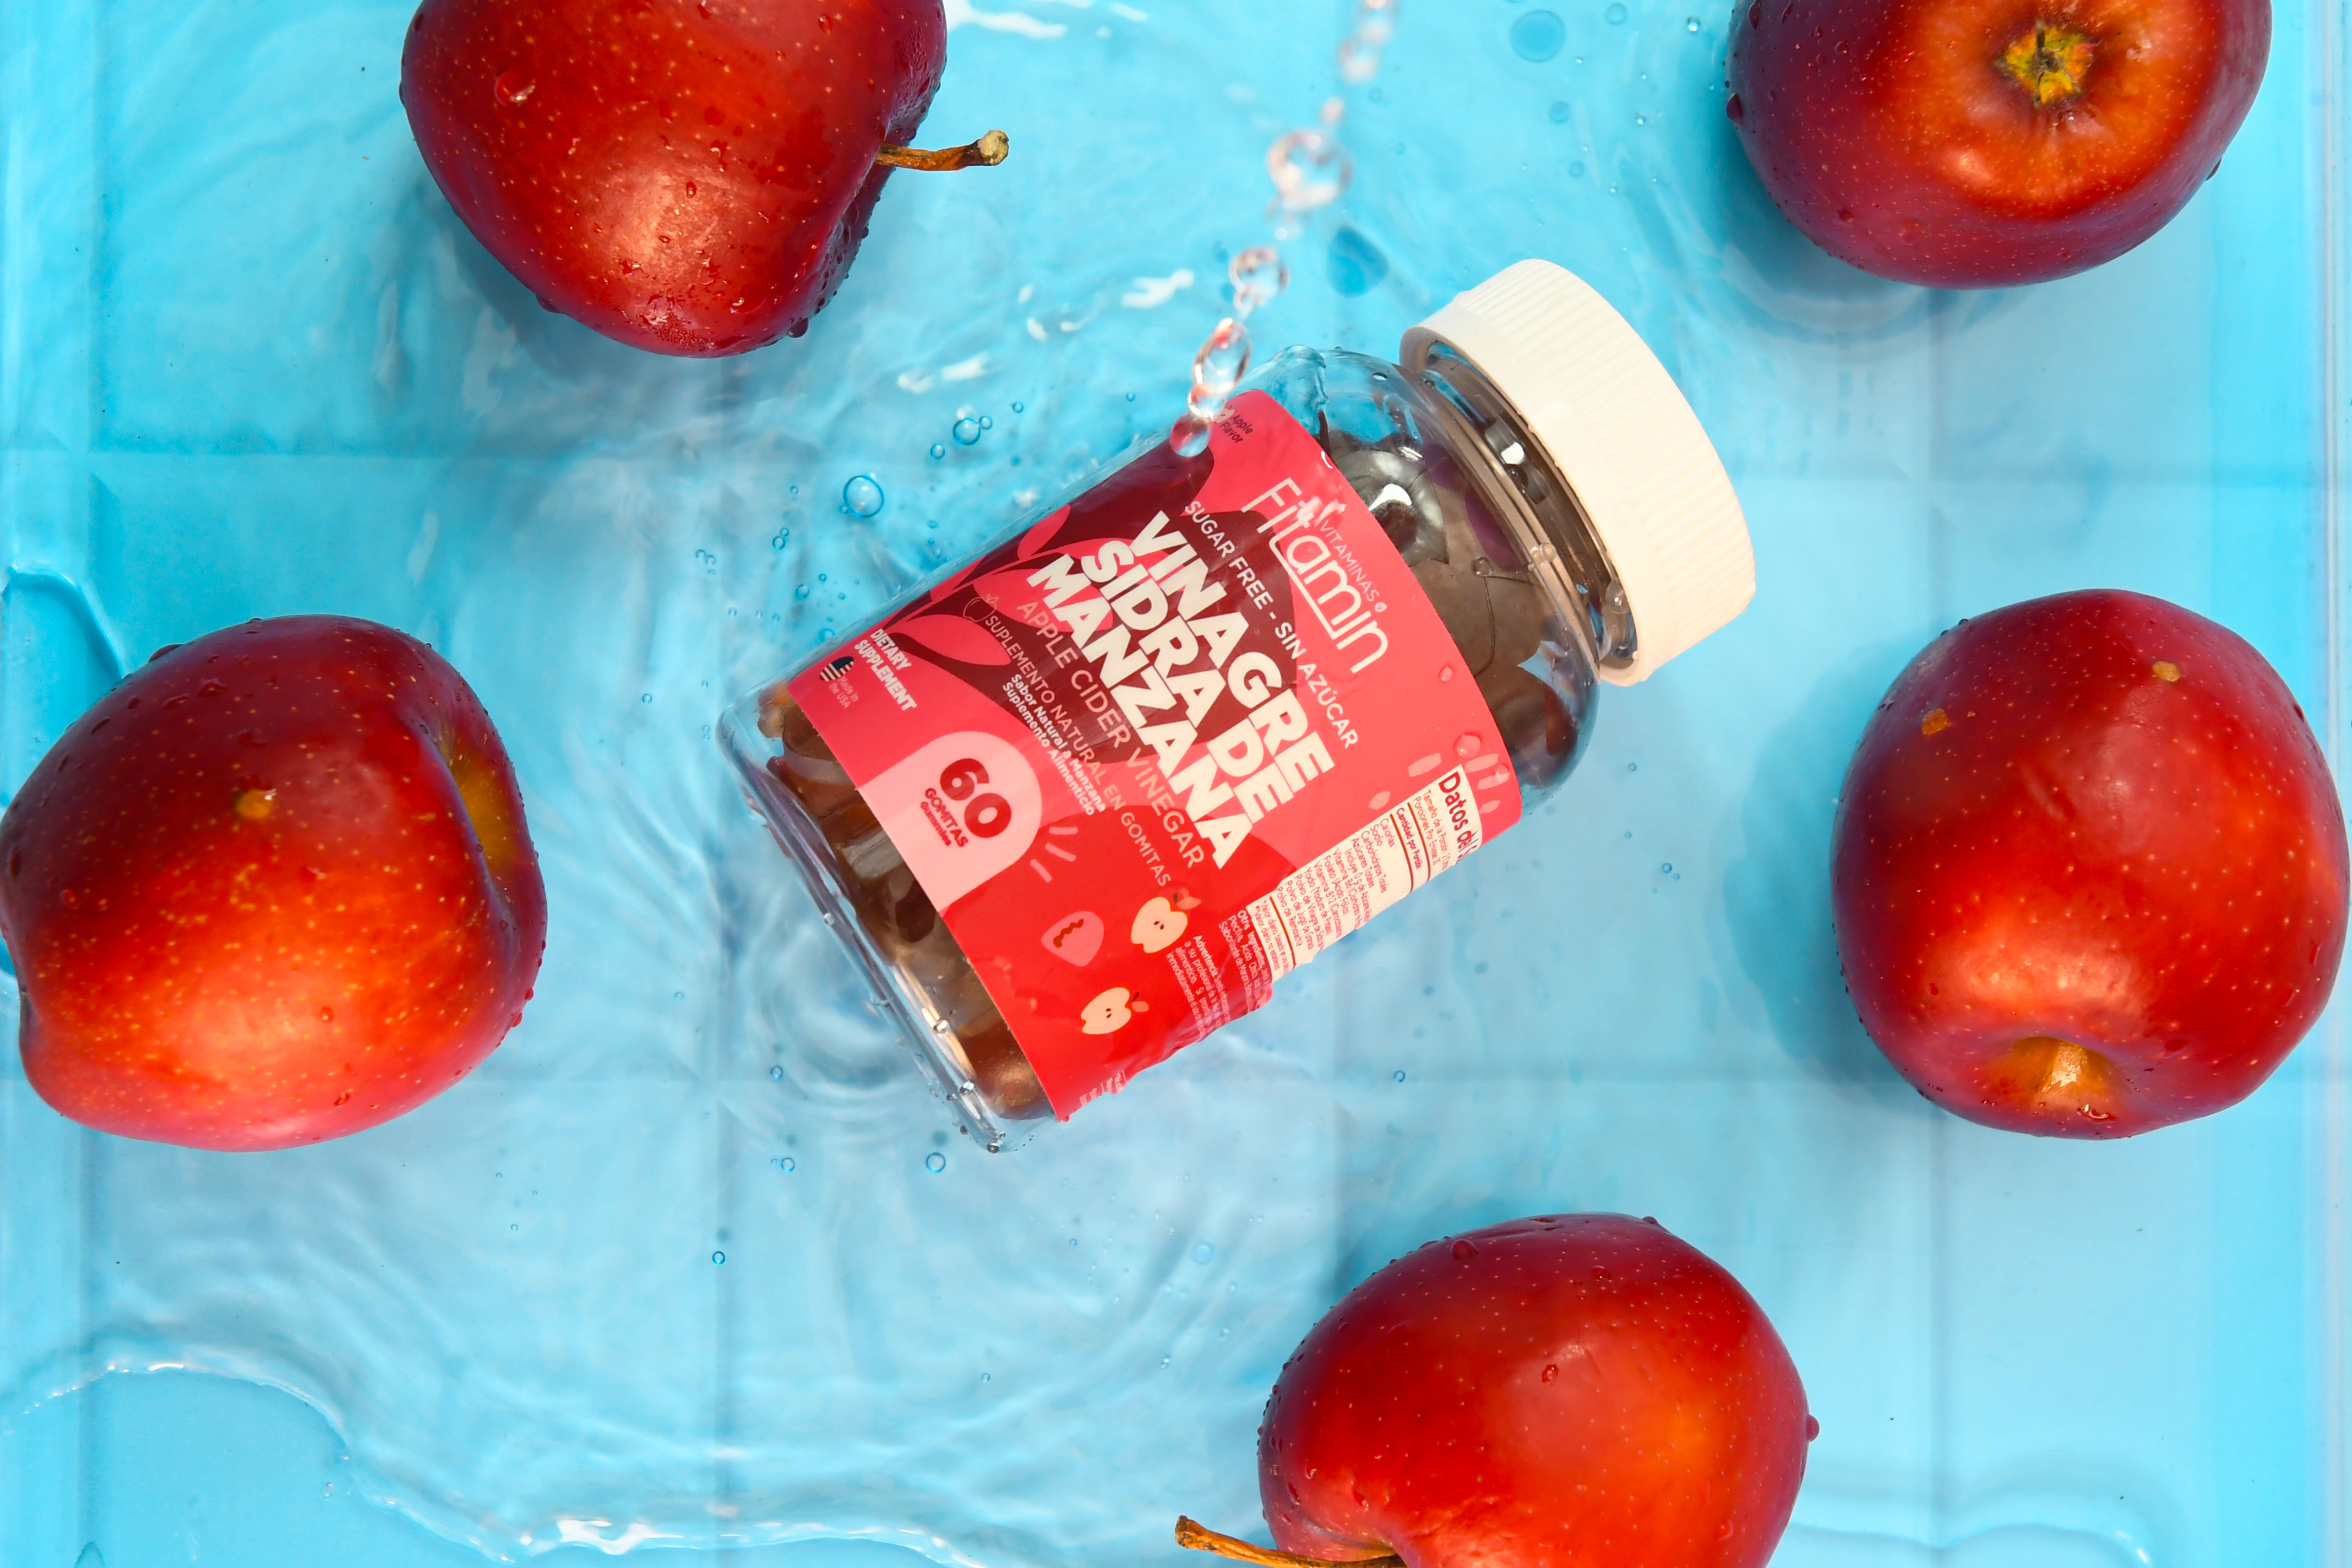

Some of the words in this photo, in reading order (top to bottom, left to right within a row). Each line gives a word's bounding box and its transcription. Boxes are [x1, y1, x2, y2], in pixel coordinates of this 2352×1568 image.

[1218, 421, 1243, 443] Flavor
[1230, 413, 1254, 435] Apple
[1317, 519, 1380, 603] VITAMINAS
[1184, 498, 1236, 558] SUGAR
[1228, 555, 1273, 611] FREE
[1273, 620, 1306, 660] SIN
[1297, 658, 1359, 749] AZÚCAR
[869, 628, 912, 671] DIETARY
[1130, 509, 1336, 793] VINAGRE
[828, 681, 841, 695] the
[836, 692, 852, 709] USA
[836, 676, 855, 695] Made
[850, 692, 861, 703] in
[853, 638, 918, 712] SUPPLEMENT
[1080, 537, 1227, 728] SIDRA
[1205, 717, 1295, 825] DE
[1025, 553, 1252, 869] MANZANA
[983, 614, 1057, 706] SUPLEMENTO
[1049, 703, 1109, 786] NATURAL
[1102, 783, 1126, 812] EN
[1118, 810, 1172, 888] GOMITAS
[1001, 681, 1052, 748] Suplemento
[1047, 747, 1096, 816] Alimenticio
[1010, 673, 1037, 707] Sabor
[1032, 705, 1068, 749] Natural
[1061, 748, 1073, 760] a
[1068, 758, 1106, 813] Manzana
[1015, 601, 1079, 669] APPLE
[1068, 666, 1133, 749] CIDER
[1124, 747, 1207, 869] VINEGAR
[922, 786, 970, 848] GOMITAS
[941, 756, 1012, 837] 60
[1412, 795, 1431, 831] Porciones
[1424, 828, 1434, 841] Por
[1422, 788, 1438, 819] Tamaño
[1437, 771, 1470, 831] Datos
[918, 799, 952, 847] Gummies
[1369, 823, 1384, 847] Sodio
[1379, 816, 1397, 847] Calorías
[1395, 807, 1415, 840] Cantidad
[1406, 839, 1417, 851] por
[1432, 817, 1441, 829] de
[1435, 825, 1444, 835] la
[1322, 854, 1337, 879] Folato
[1331, 848, 1348, 880] Vitamina
[1343, 848, 1358, 874] Incluye
[1358, 883, 1364, 892] de
[1350, 836, 1368, 868] Azúcares
[1363, 865, 1374, 888] Totales
[1359, 829, 1384, 876] Carbohidratos
[1273, 886, 1288, 908] Polvo
[1283, 907, 1292, 917] de
[1284, 880, 1297, 902] Polvo
[1293, 873, 1307, 896] Polvo
[1302, 894, 1310, 905] de
[1306, 902, 1318, 926] Vinagre
[1314, 924, 1320, 933] de
[1303, 866, 1317, 888] Yodo
[1320, 910, 1327, 919] de
[1312, 860, 1330, 892] Vitamina
[1325, 890, 1336, 905] B12
[1292, 900, 1301, 912] de
[1296, 910, 1306, 927] Jugo
[1302, 924, 1309, 934] de
[1187, 948, 1196, 959] su
[1235, 956, 1243, 967] de
